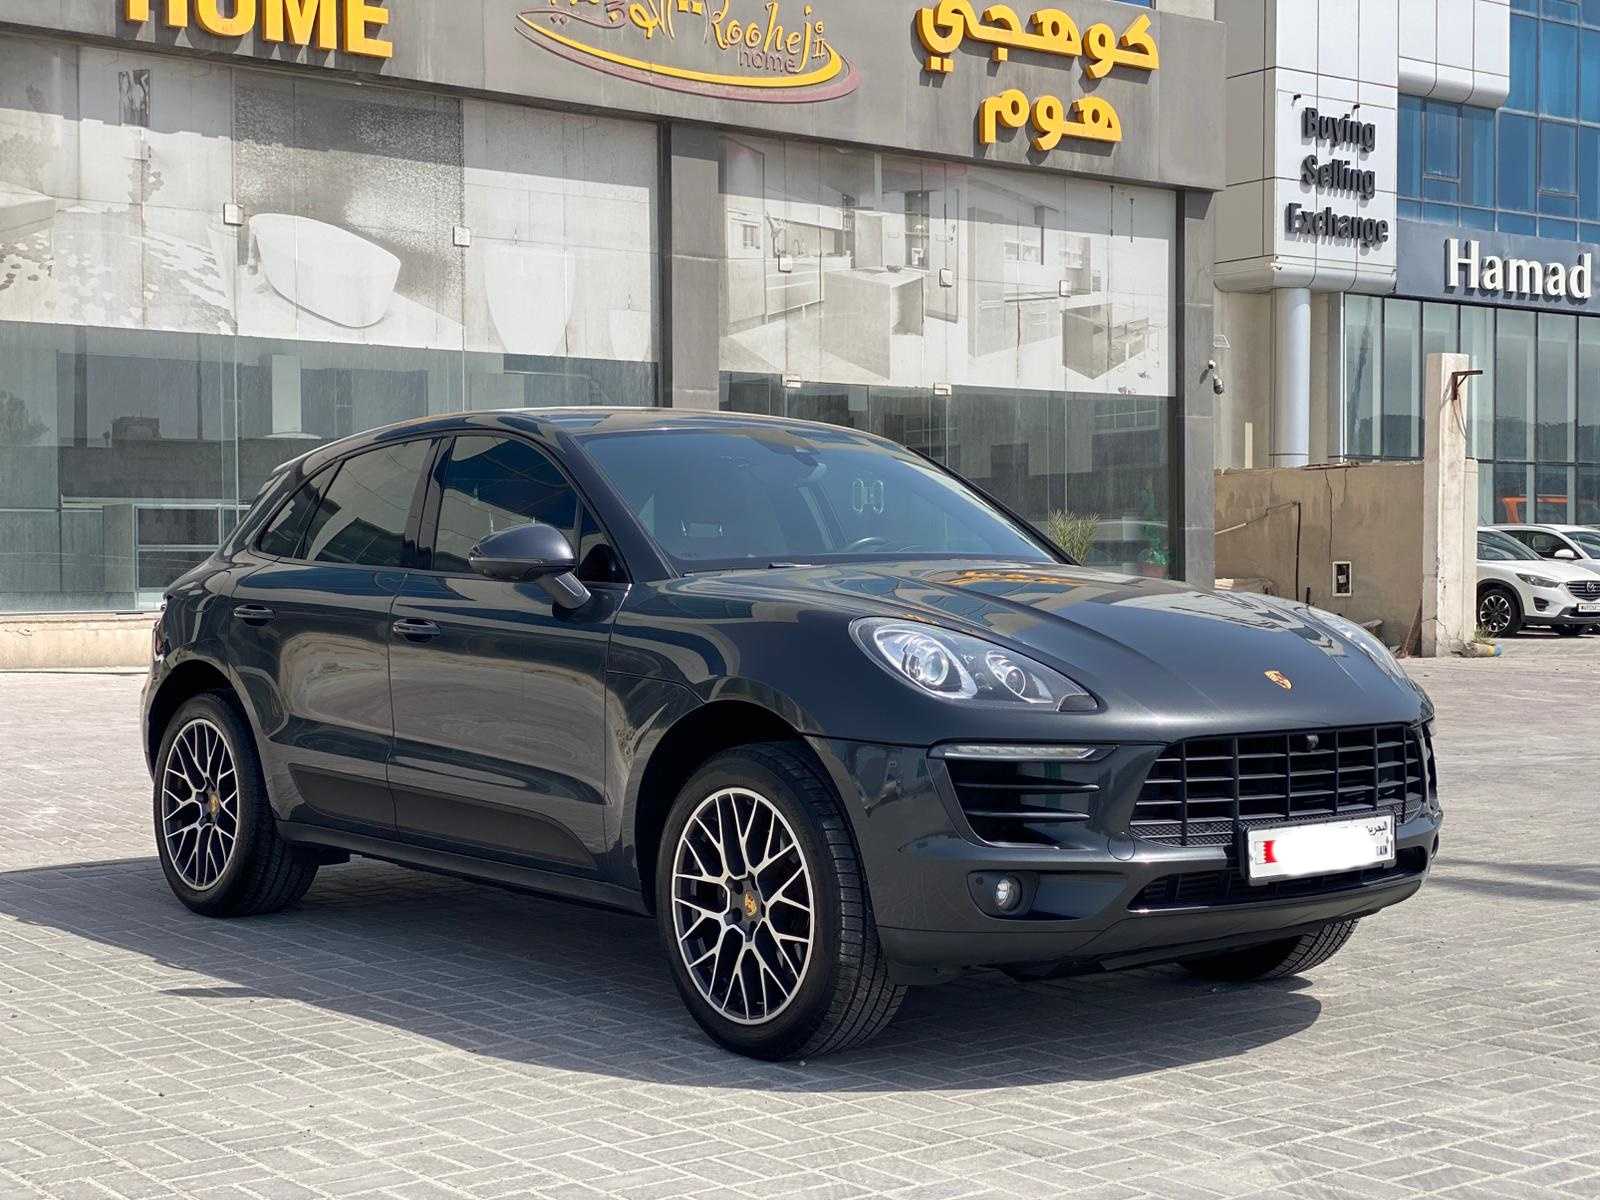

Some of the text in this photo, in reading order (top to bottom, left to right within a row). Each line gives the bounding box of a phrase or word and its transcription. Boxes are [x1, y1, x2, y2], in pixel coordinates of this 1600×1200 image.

[126, 0, 393, 58] ME
[915, 0, 1160, 80] كوهجي
[737, 43, 799, 74] home
[979, 88, 1122, 151] هوم
[1301, 107, 1376, 153] Buying
[1301, 155, 1376, 200] Selling
[1284, 203, 1389, 246] Exchange
[1444, 238, 1592, 299] Hamad
